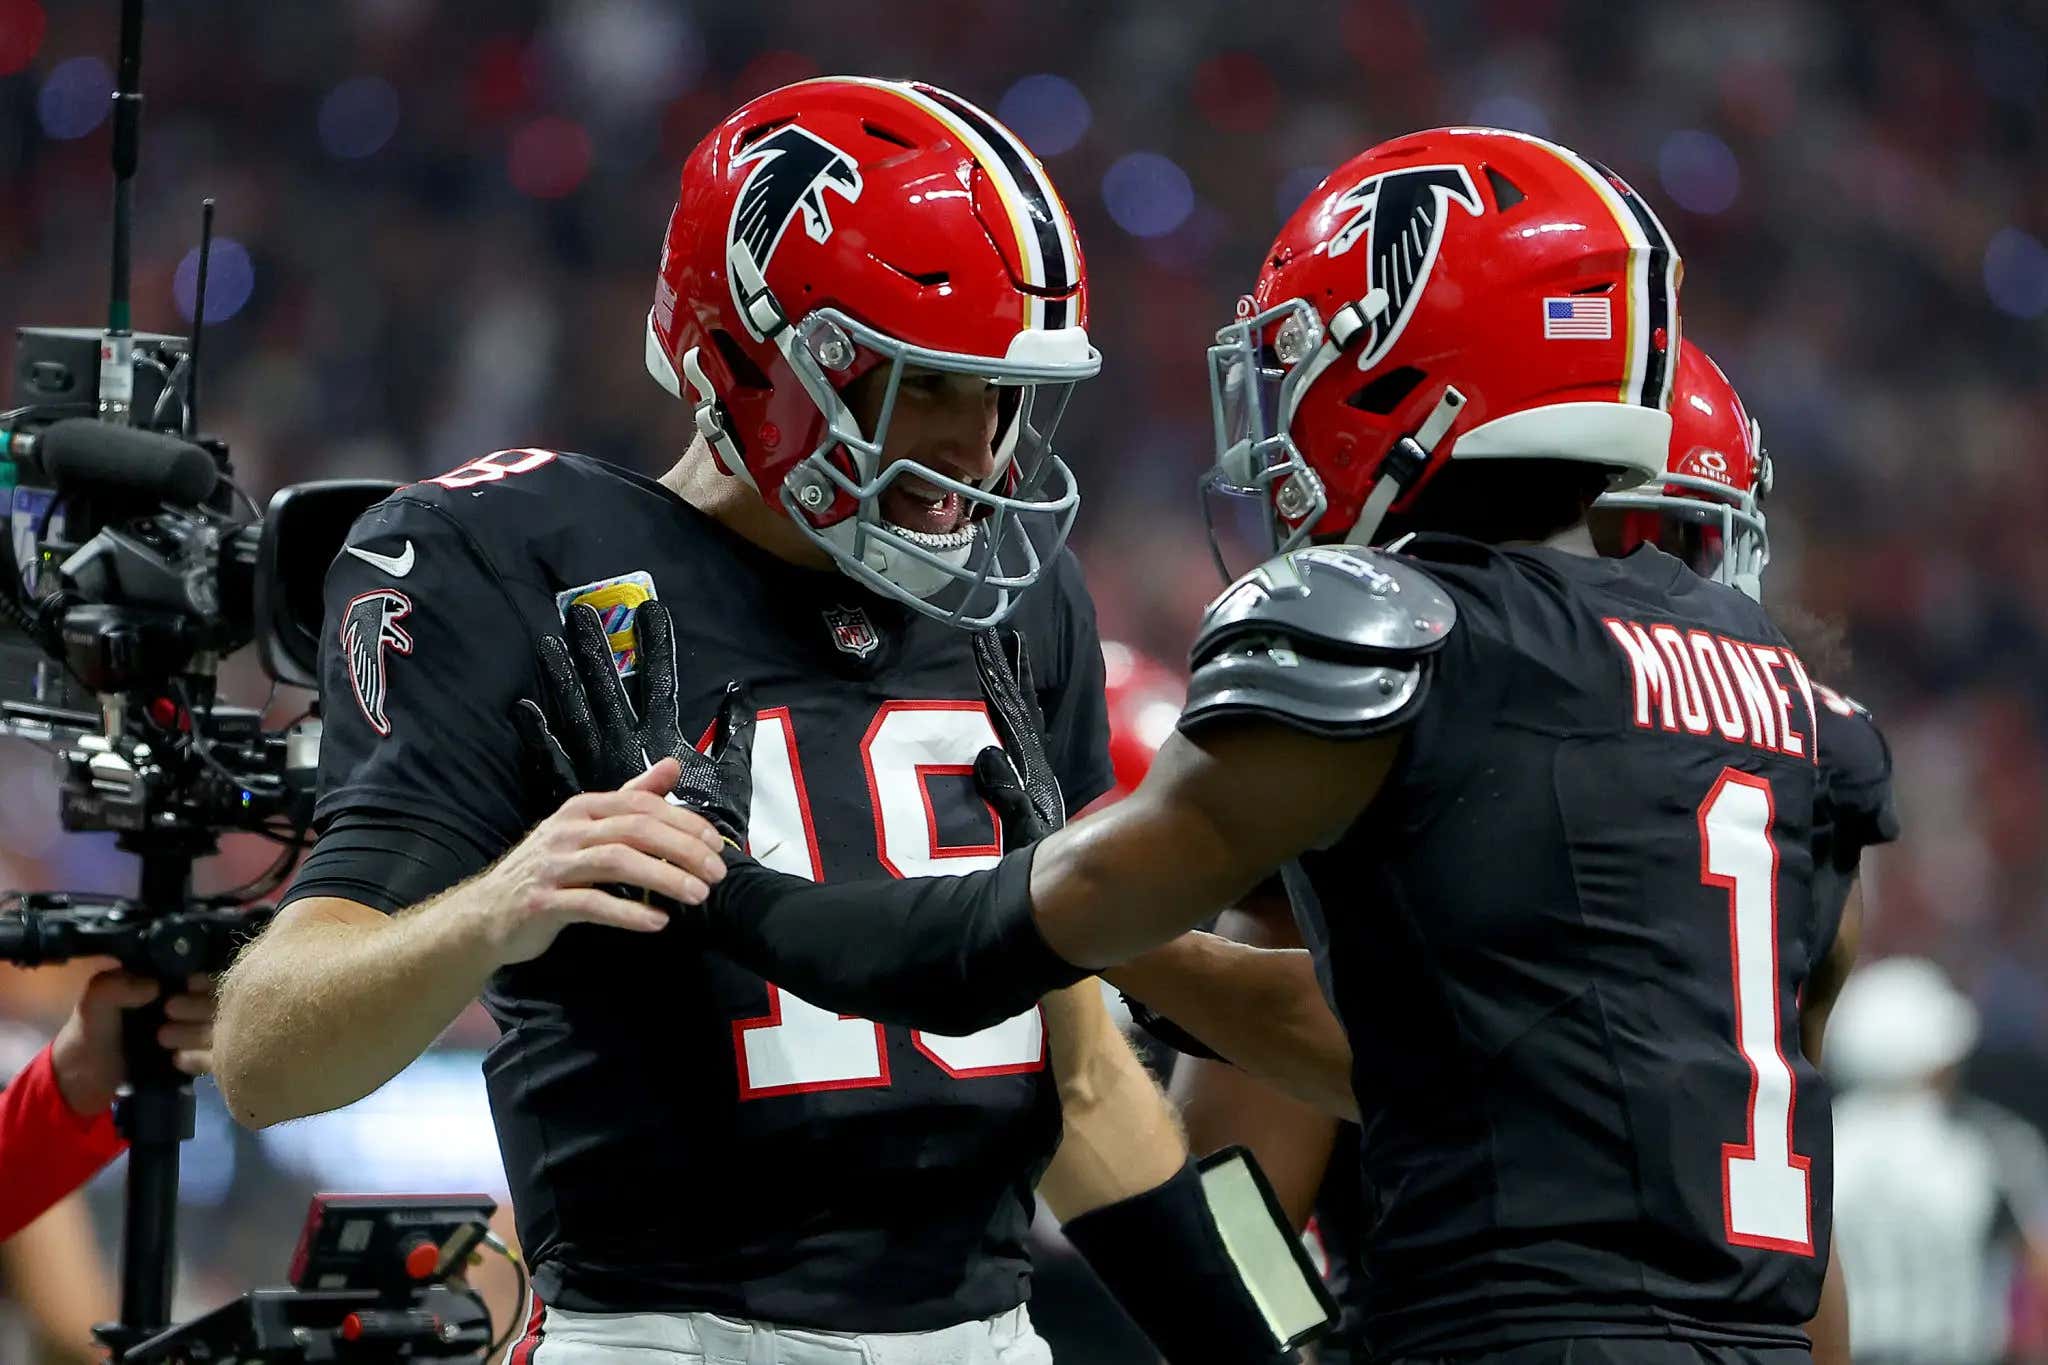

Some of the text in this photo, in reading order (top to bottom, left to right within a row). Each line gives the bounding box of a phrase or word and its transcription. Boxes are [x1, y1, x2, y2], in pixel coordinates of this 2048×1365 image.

[835, 625, 873, 649] NFL
[1601, 616, 1819, 767] MOONEY
[1697, 766, 1815, 1258] 1
